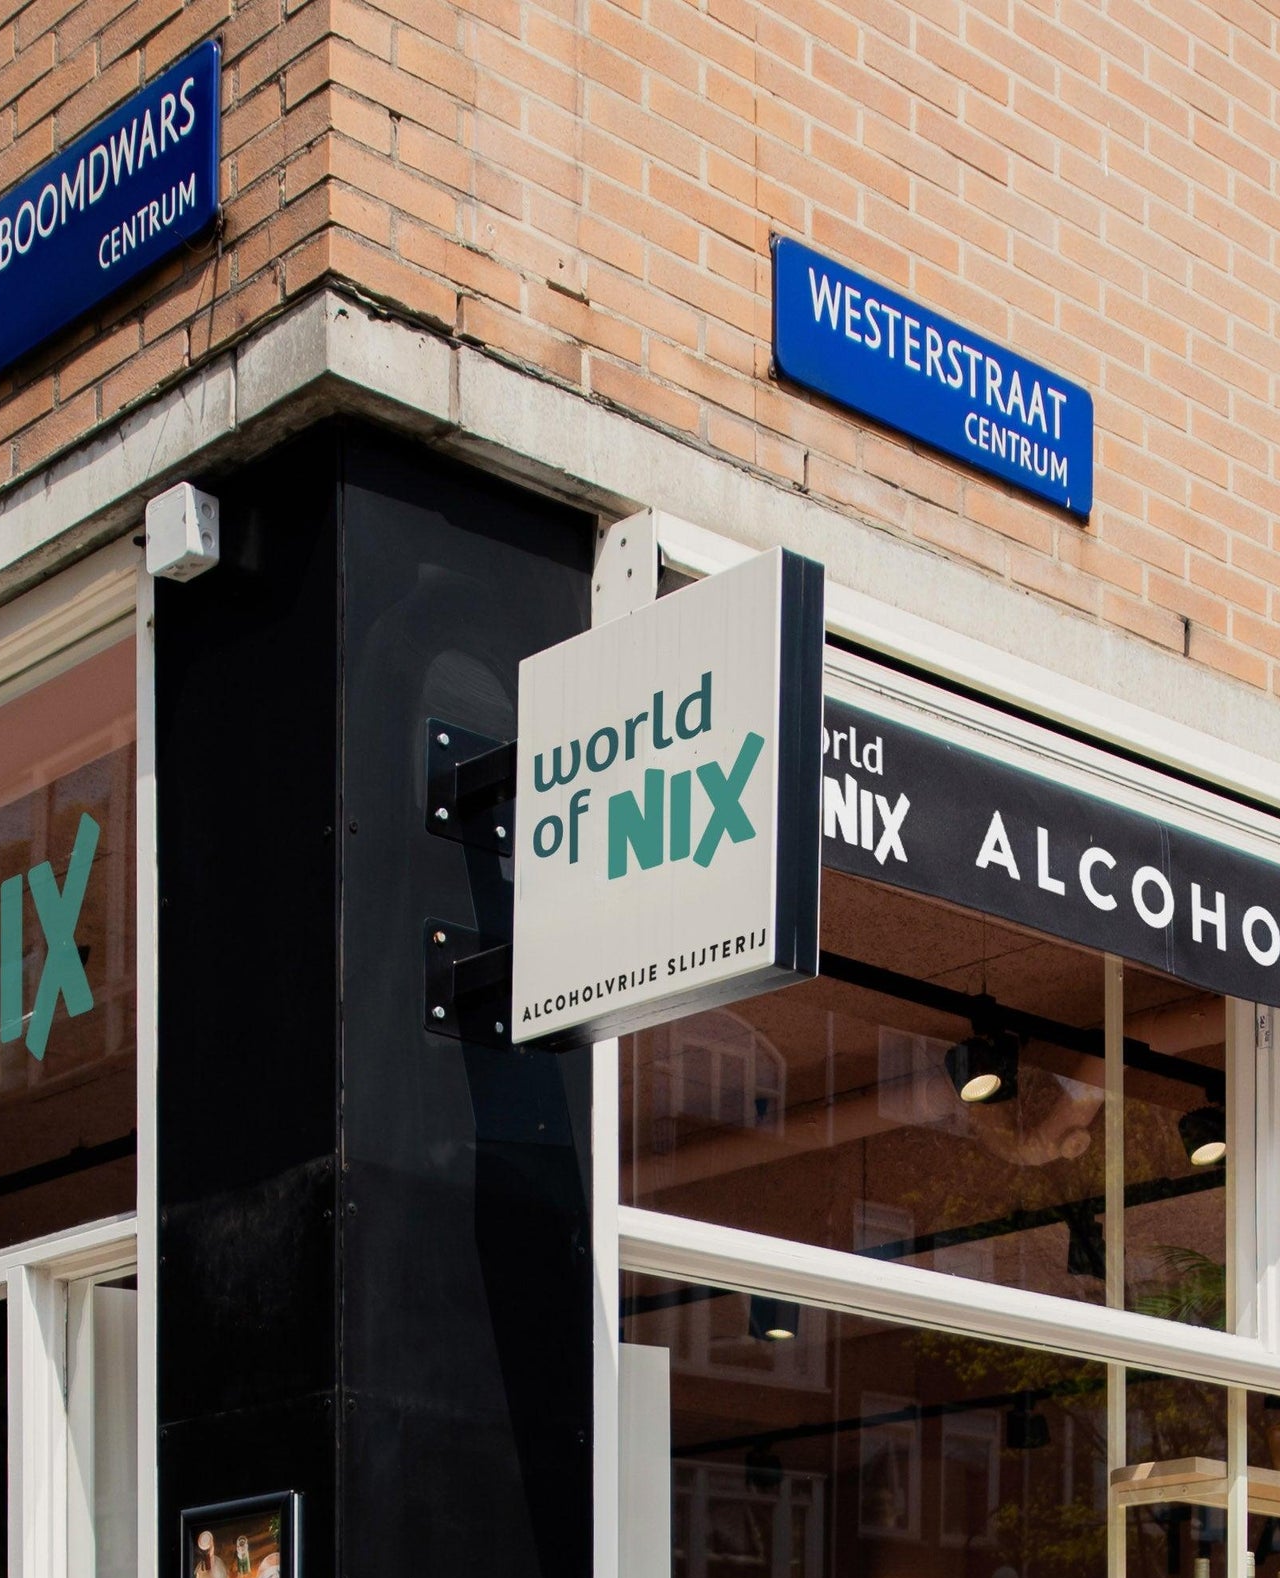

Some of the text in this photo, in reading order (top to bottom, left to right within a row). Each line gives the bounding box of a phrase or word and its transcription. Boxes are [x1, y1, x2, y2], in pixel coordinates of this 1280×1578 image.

[99, 173, 196, 270] CENTRUM
[808, 267, 1067, 440] WESTERSTRAAT
[965, 412, 1067, 487] CENTRUM
[534, 671, 712, 793] world
[533, 731, 765, 880] of NIX
[823, 774, 911, 865] NIX
[522, 928, 768, 1023] ALCOHOLVRIJE SLIJTERIJ
